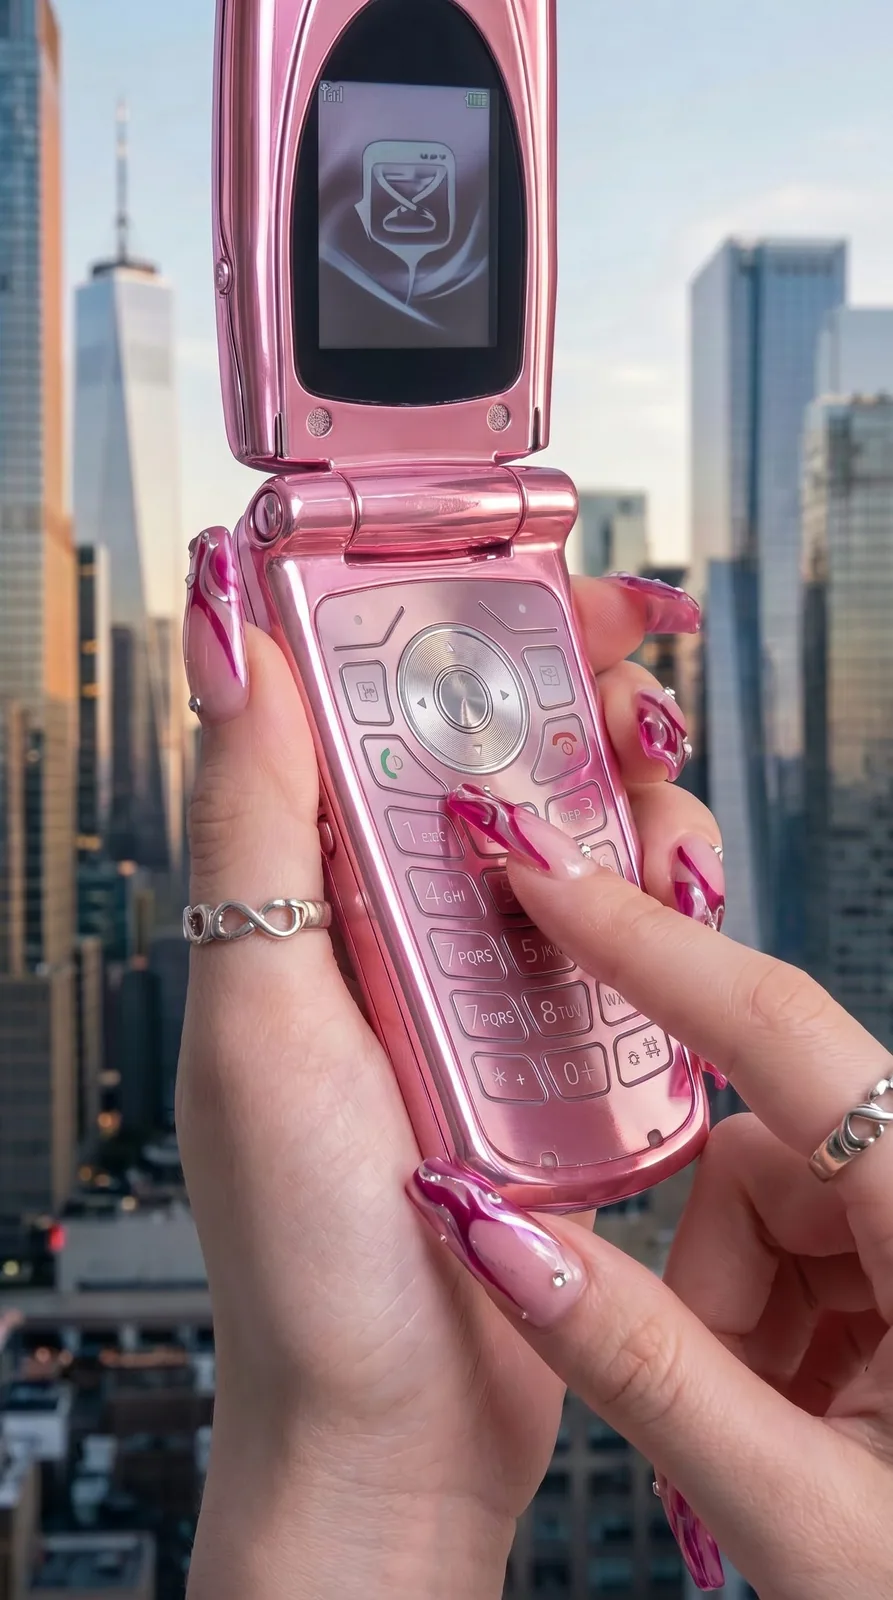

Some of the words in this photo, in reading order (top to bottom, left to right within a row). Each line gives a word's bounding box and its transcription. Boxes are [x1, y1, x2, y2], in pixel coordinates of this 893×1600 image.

[579, 797, 596, 820] 3
[402, 821, 416, 844] 1
[425, 881, 441, 905] 4
[443, 890, 466, 904] GHI
[440, 942, 454, 967] 7
[457, 949, 493, 966] PQRS
[521, 939, 538, 963] 5
[464, 1004, 478, 1030] 7
[480, 1010, 515, 1028] PQRS
[540, 1000, 557, 1024] 8
[557, 1003, 581, 1020] TUV
